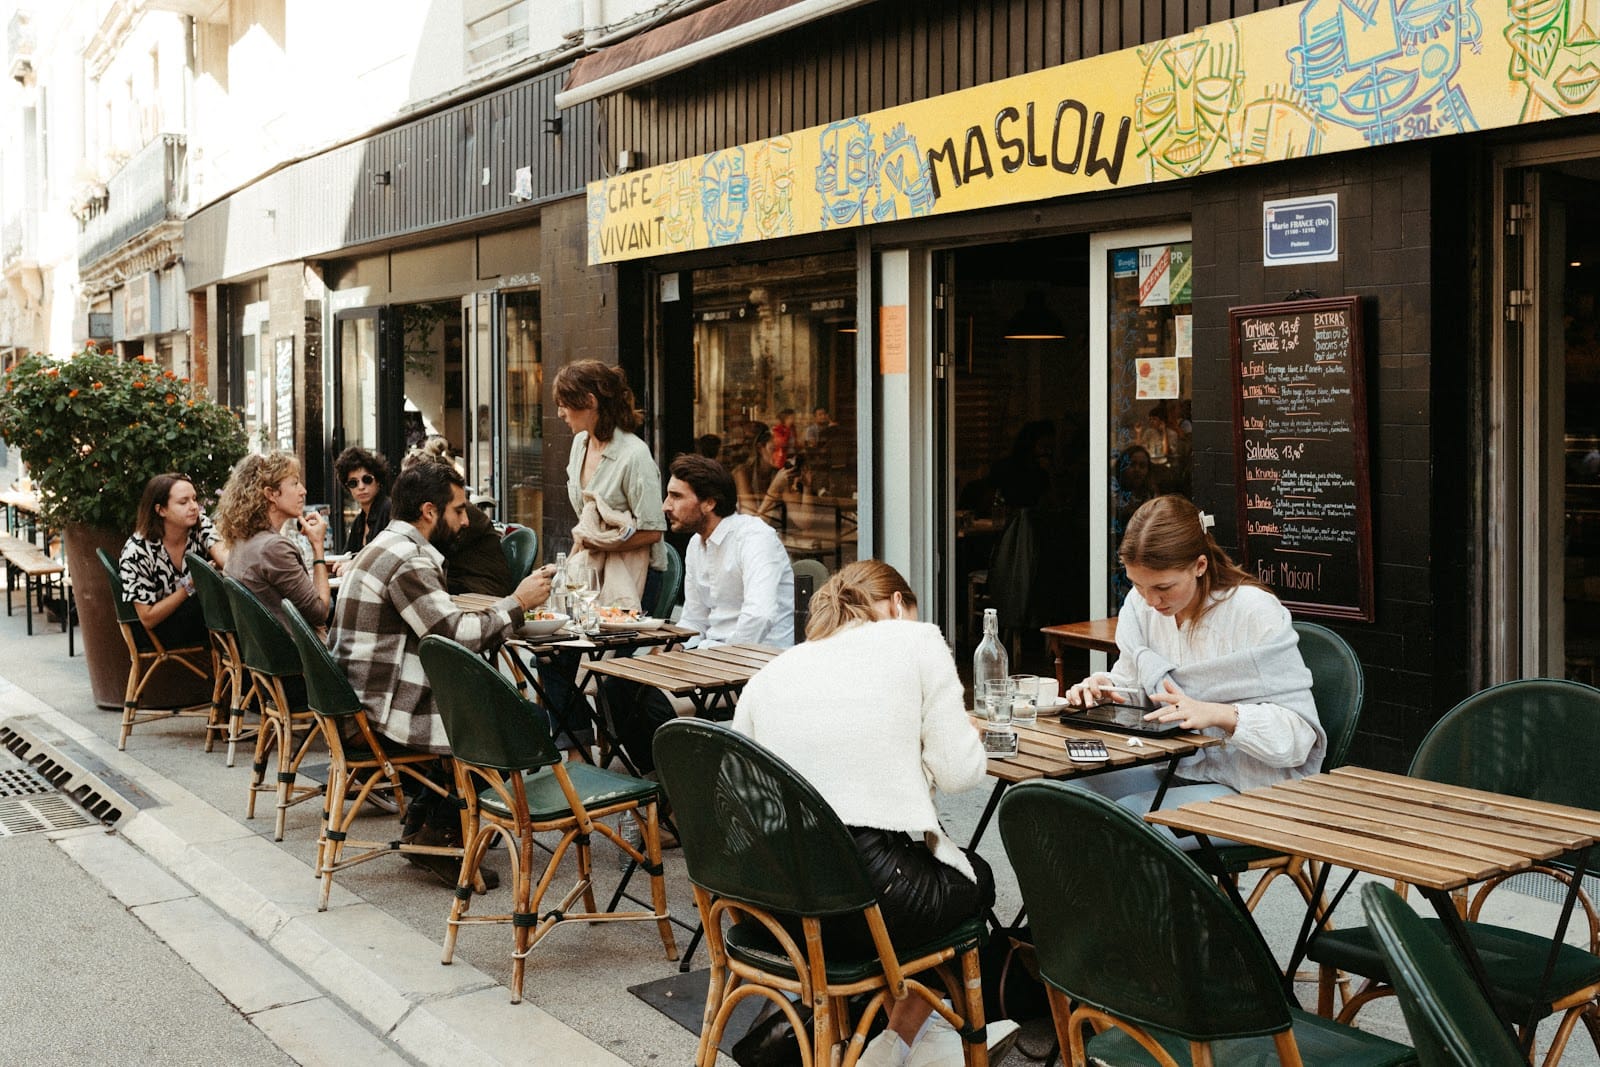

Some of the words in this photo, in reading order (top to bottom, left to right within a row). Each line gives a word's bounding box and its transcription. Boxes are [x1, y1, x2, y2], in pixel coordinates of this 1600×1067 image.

[927, 99, 1131, 199] MASLOW
[608, 173, 652, 213] CAFE
[1271, 222, 1289, 230] Marie
[1290, 219, 1314, 229] FRANCE
[1315, 218, 1329, 228] (De)
[599, 216, 665, 256] VIVANT
[1141, 254, 1151, 268] III
[1170, 251, 1183, 264] PR
[1139, 252, 1170, 300] LICENCE
[1242, 319, 1276, 338] Tartines
[1314, 312, 1345, 326] EXTRAS
[1245, 440, 1279, 459] Salades
[1257, 559, 1276, 585] Fait
[1280, 561, 1314, 591] Maison
